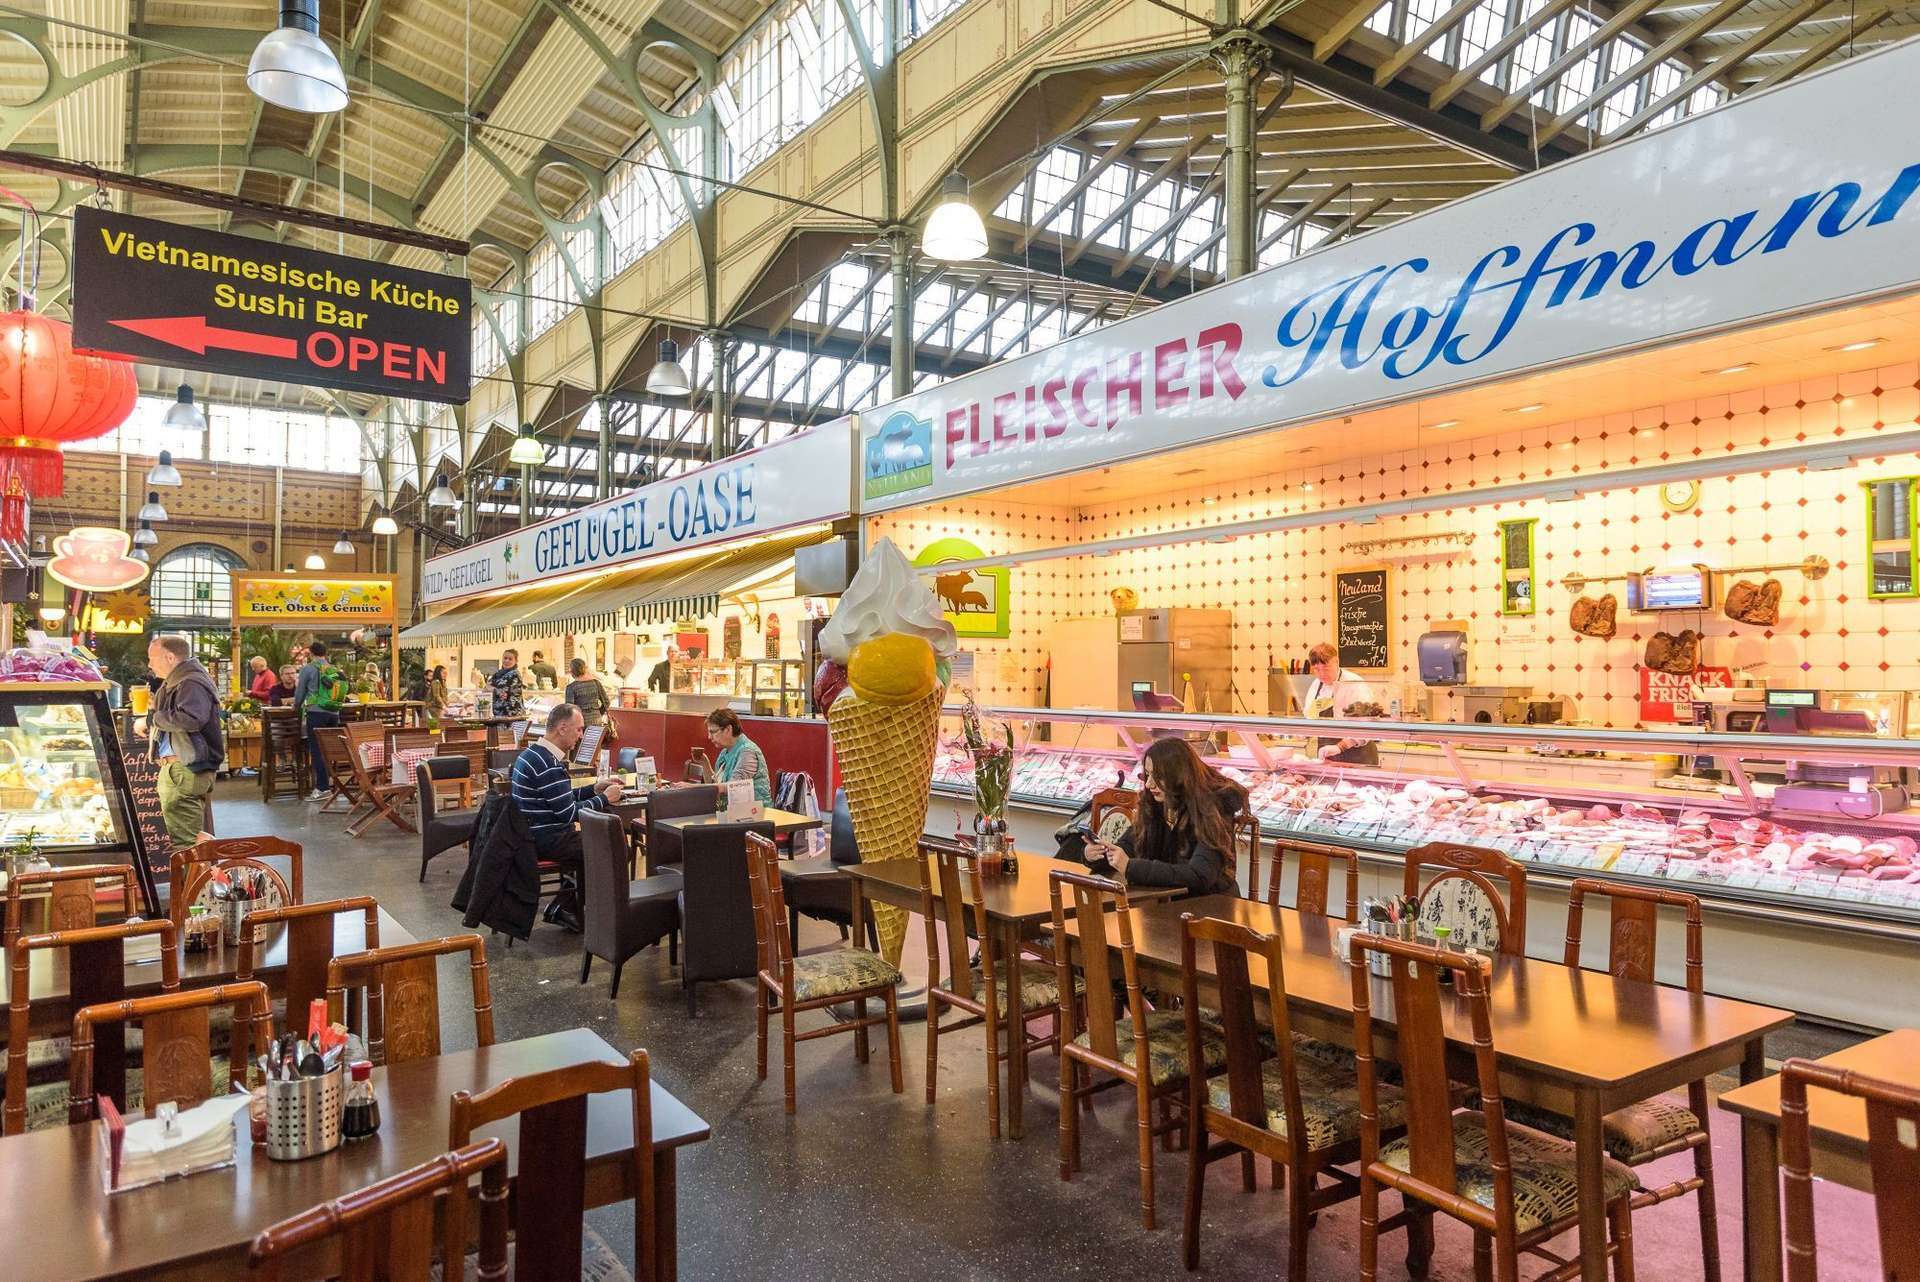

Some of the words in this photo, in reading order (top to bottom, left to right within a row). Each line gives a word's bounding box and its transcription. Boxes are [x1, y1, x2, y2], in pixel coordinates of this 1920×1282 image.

[101, 228, 360, 298] Vietnamesische
[370, 278, 460, 315] Küche
[214, 283, 305, 320] Sushi
[315, 300, 368, 330] Bar
[306, 331, 446, 384] OPEN
[945, 322, 1247, 470] FLEISCHER
[535, 463, 758, 573] GEFLÜGEL-OASE
[449, 558, 494, 590] GEFLÜGEL
[251, 602, 282, 613] Eier,
[286, 602, 317, 613] Obst
[319, 603, 330, 612] &
[332, 603, 383, 613] Gemüse
[1648, 671, 1726, 688] KNACK
